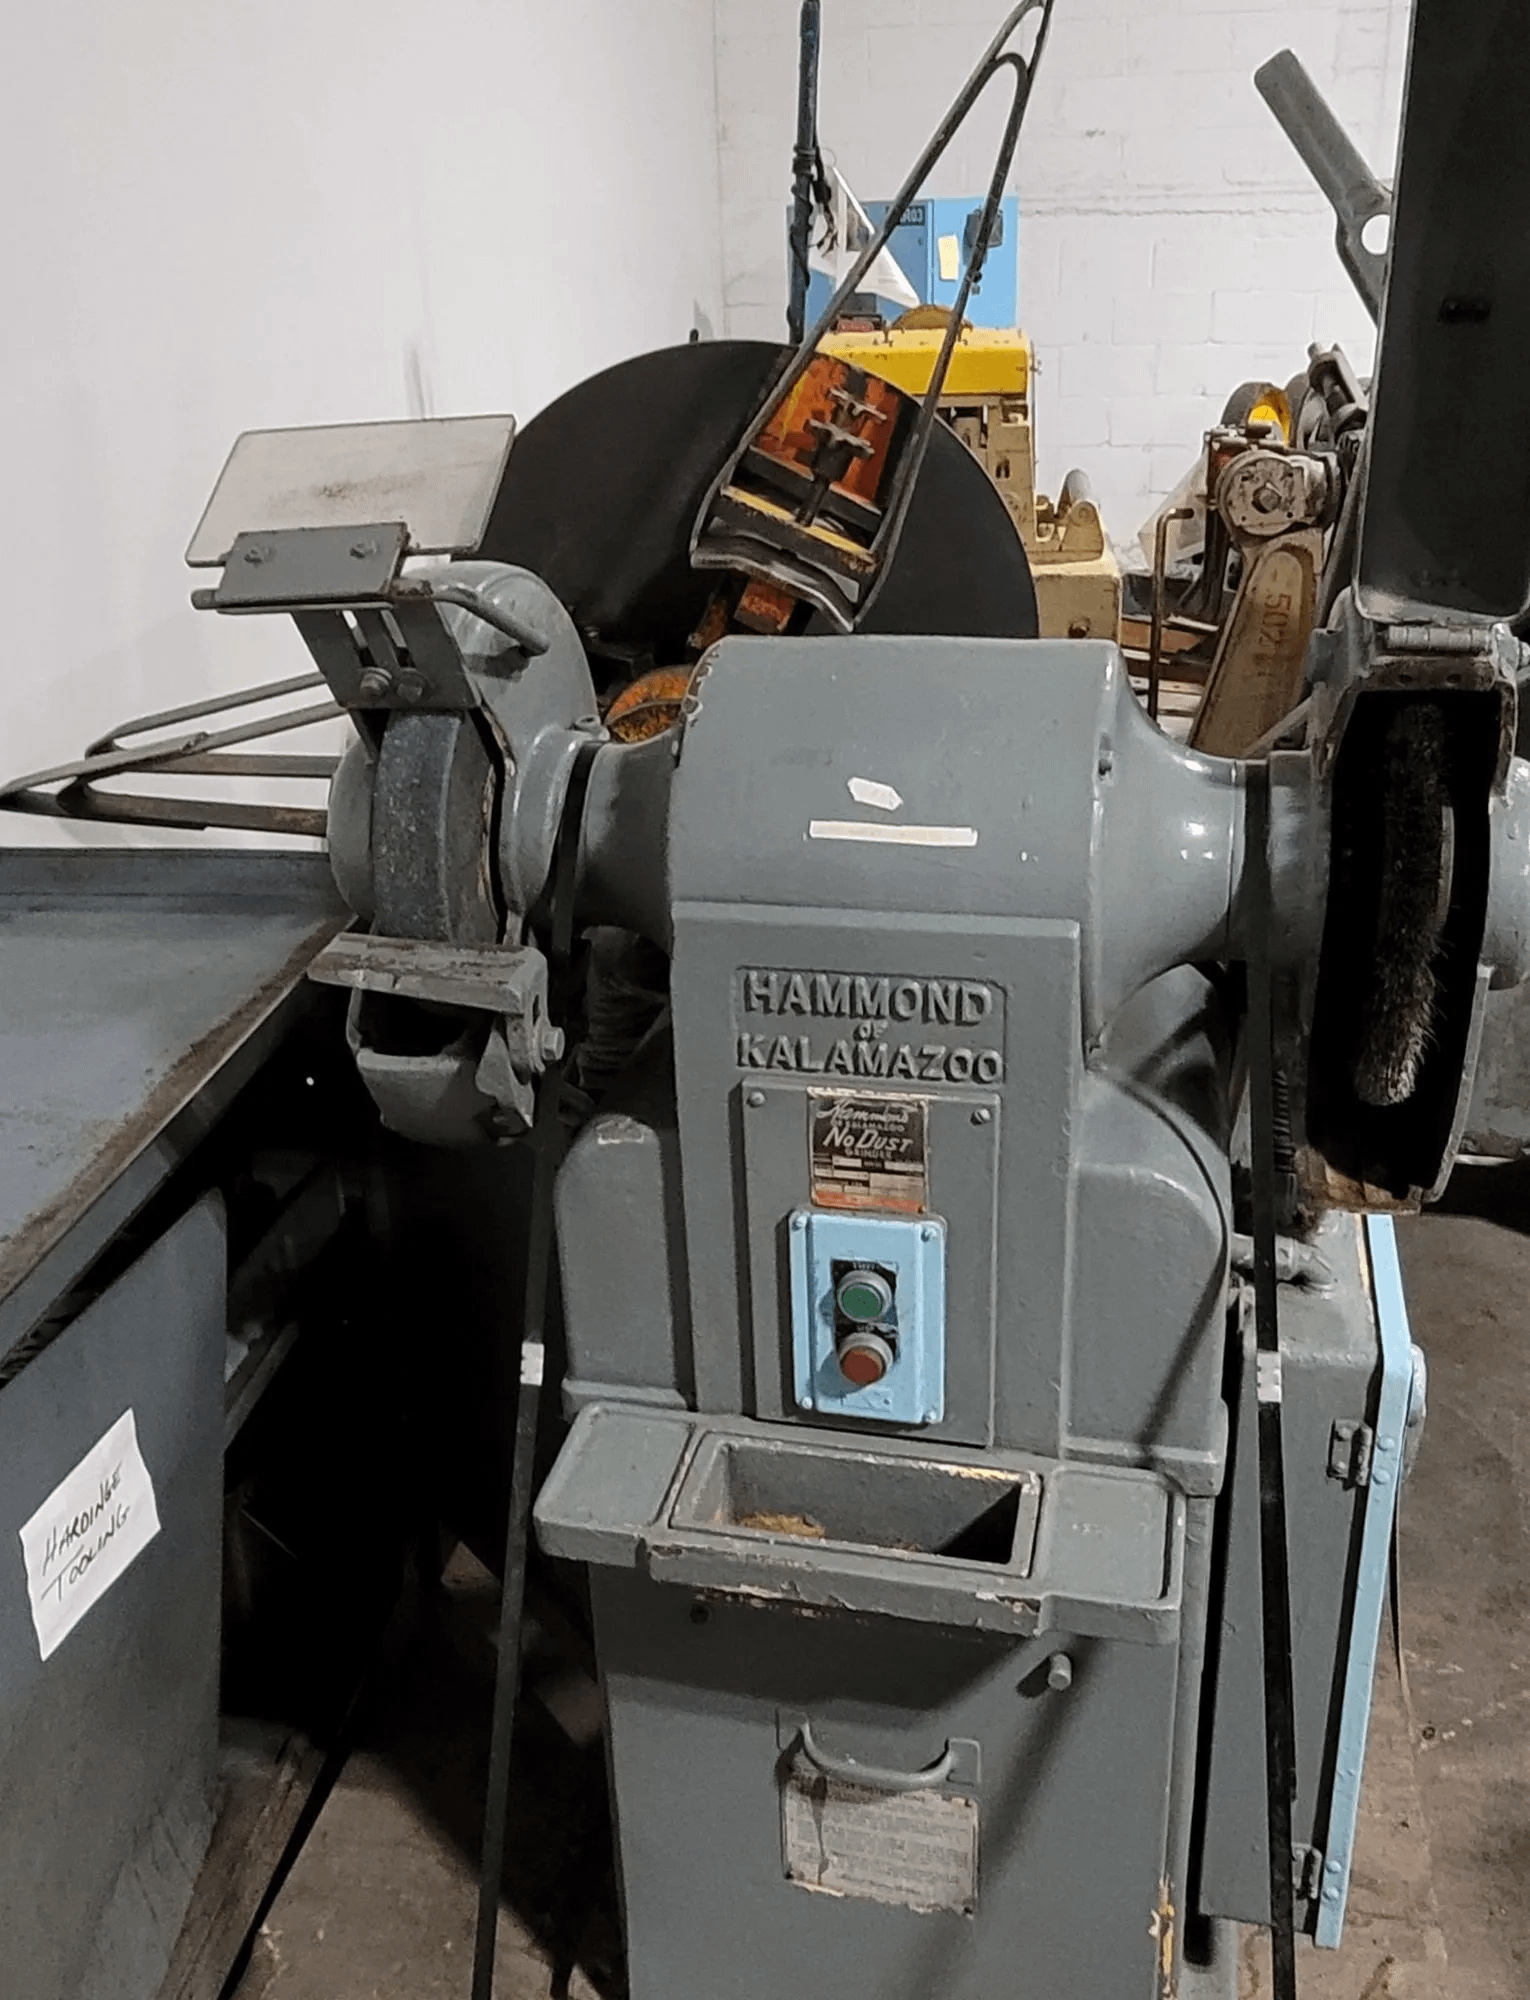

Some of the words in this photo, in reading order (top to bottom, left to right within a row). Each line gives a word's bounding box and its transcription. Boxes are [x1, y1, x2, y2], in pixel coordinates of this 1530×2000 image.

[743, 970, 993, 1026] HAMMOND
[736, 1032, 1002, 1084] KALAMAZOO
[853, 1020, 888, 1042] OF
[855, 1128, 914, 1153] DUST
[41, 1460, 123, 1577] HARDINGE
[40, 1503, 131, 1602] TOOLING
